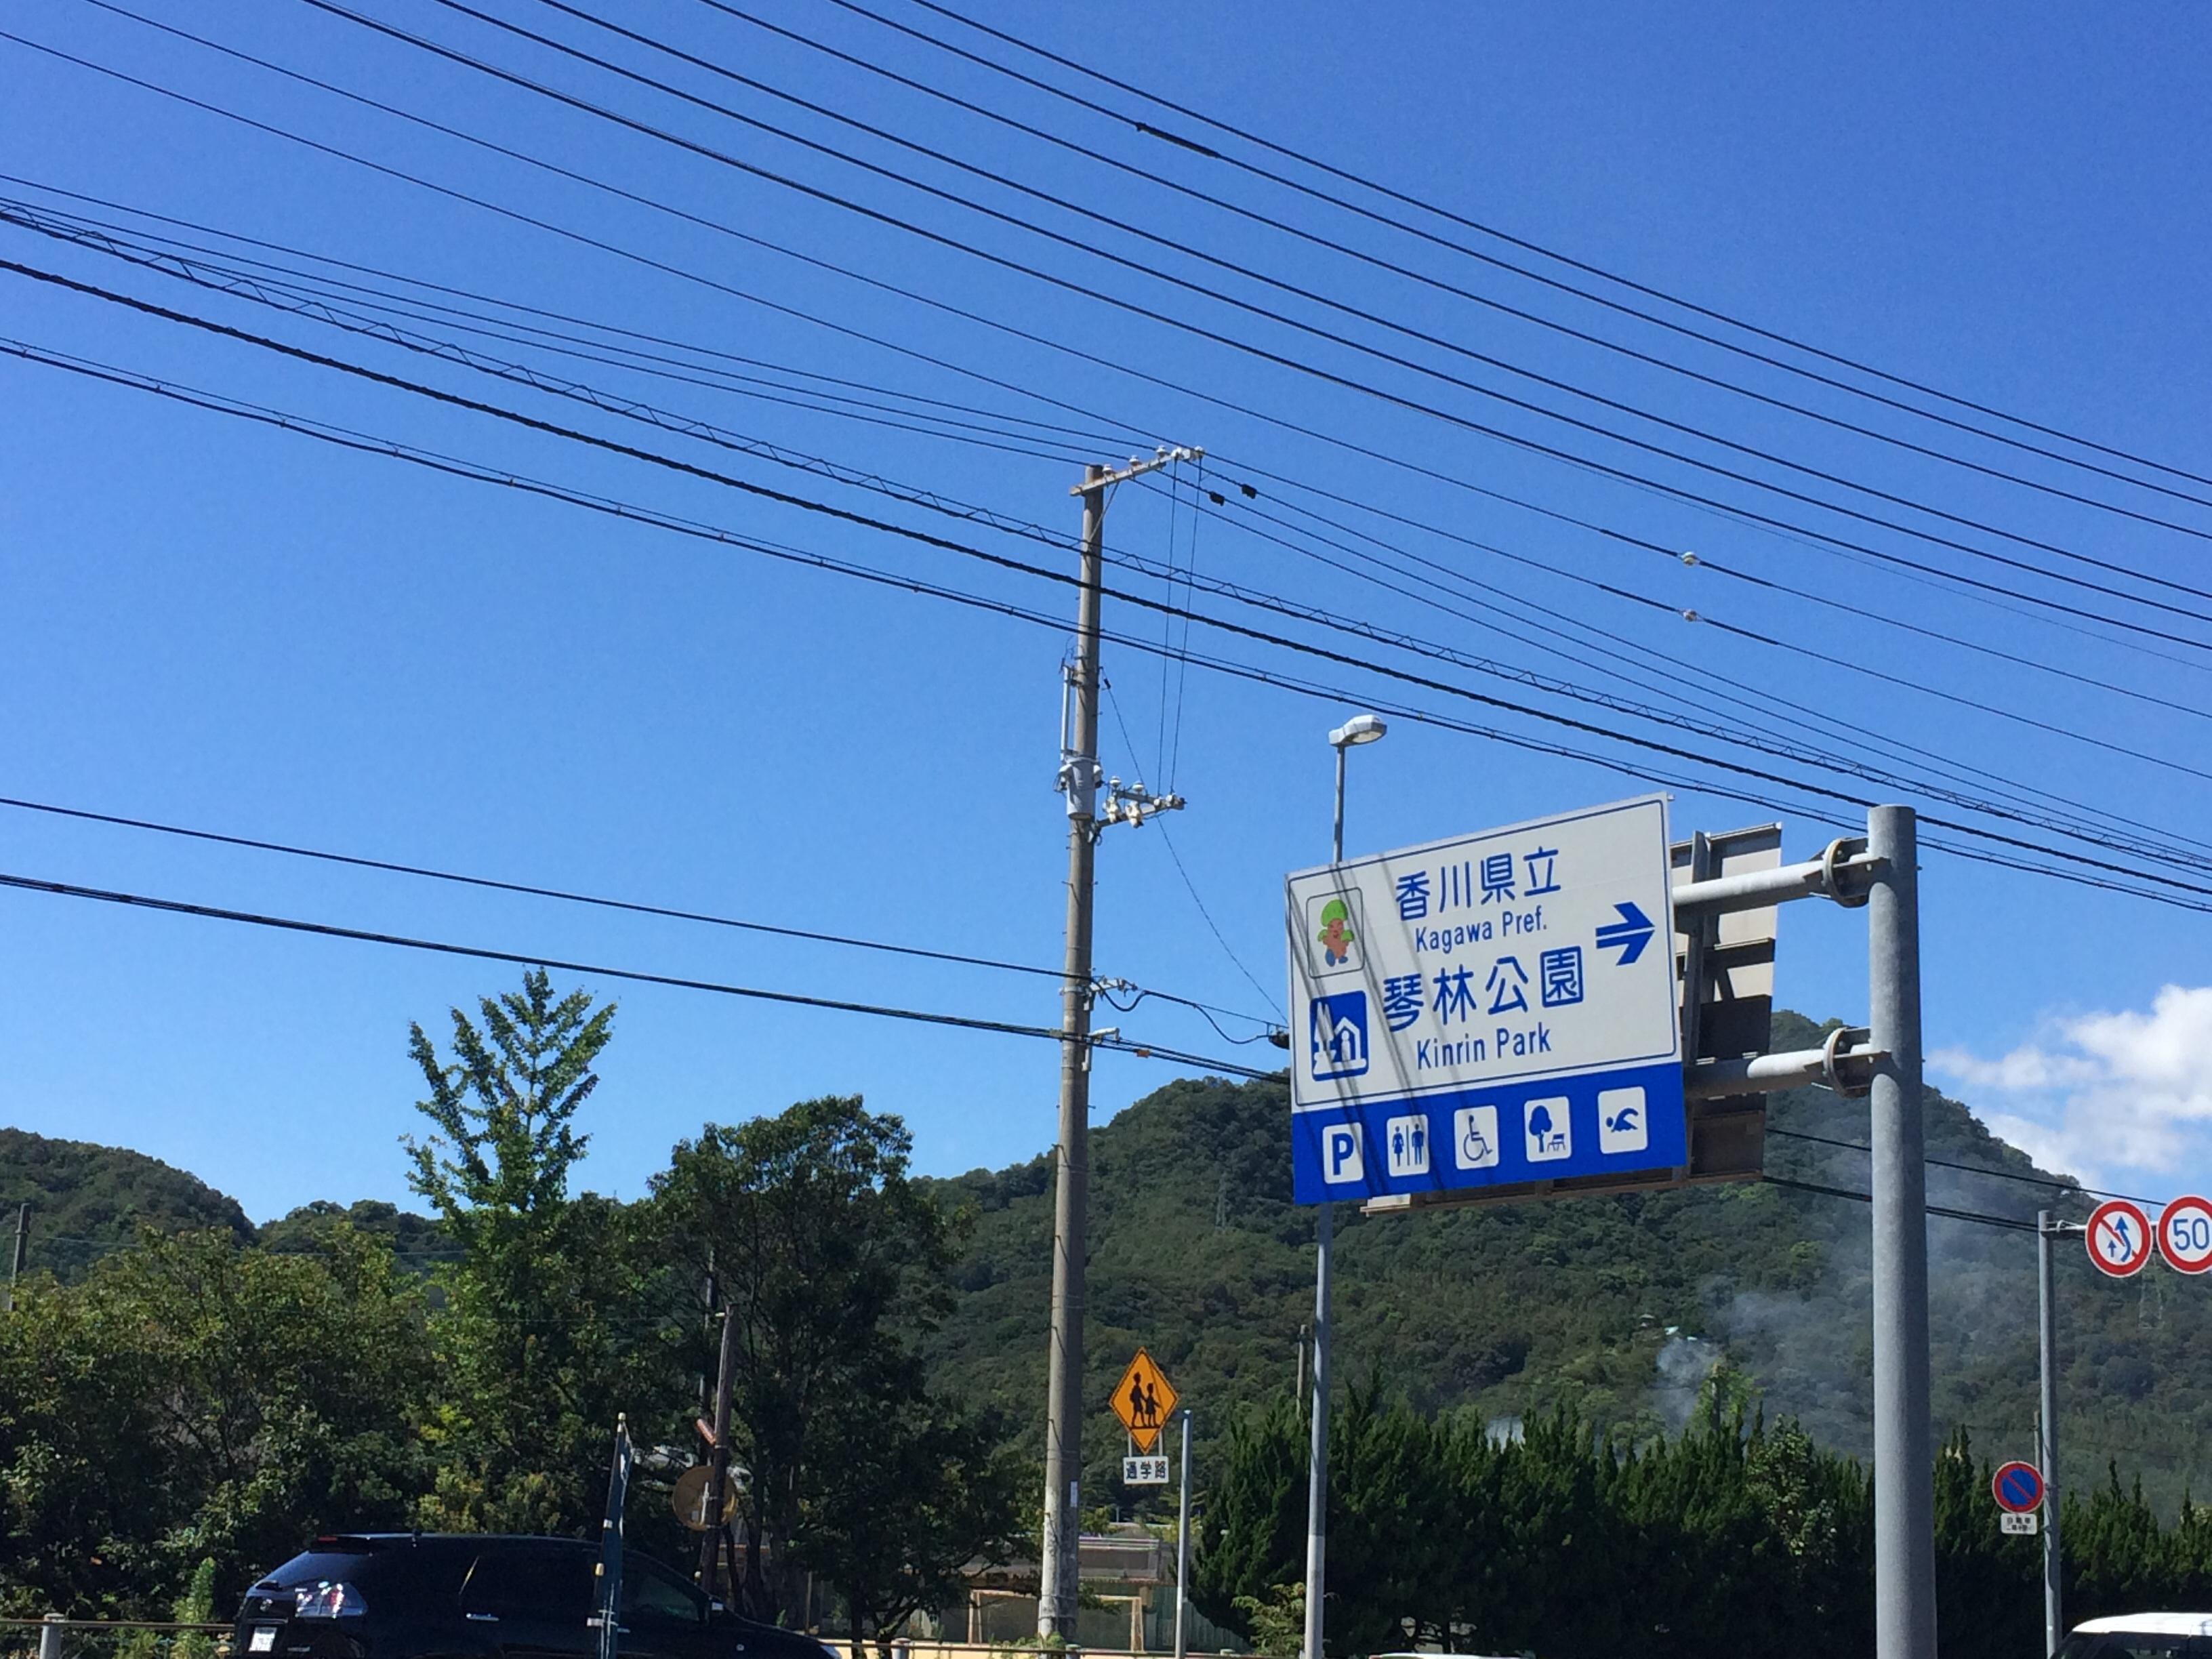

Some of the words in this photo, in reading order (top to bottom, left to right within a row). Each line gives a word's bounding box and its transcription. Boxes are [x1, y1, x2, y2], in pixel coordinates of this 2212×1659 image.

[1395, 846, 1561, 920] 香川県立
[1416, 922, 1492, 954] Kagawa
[1502, 907, 1548, 936] Pref.
[1383, 945, 1584, 1032] 琴林公園
[1417, 1035, 1486, 1069] Kinrin
[1496, 1022, 1551, 1059] Park
[1332, 1132, 1354, 1176] P
[2173, 1217, 2210, 1250] 50
[1126, 1460, 1166, 1479] 通学路
